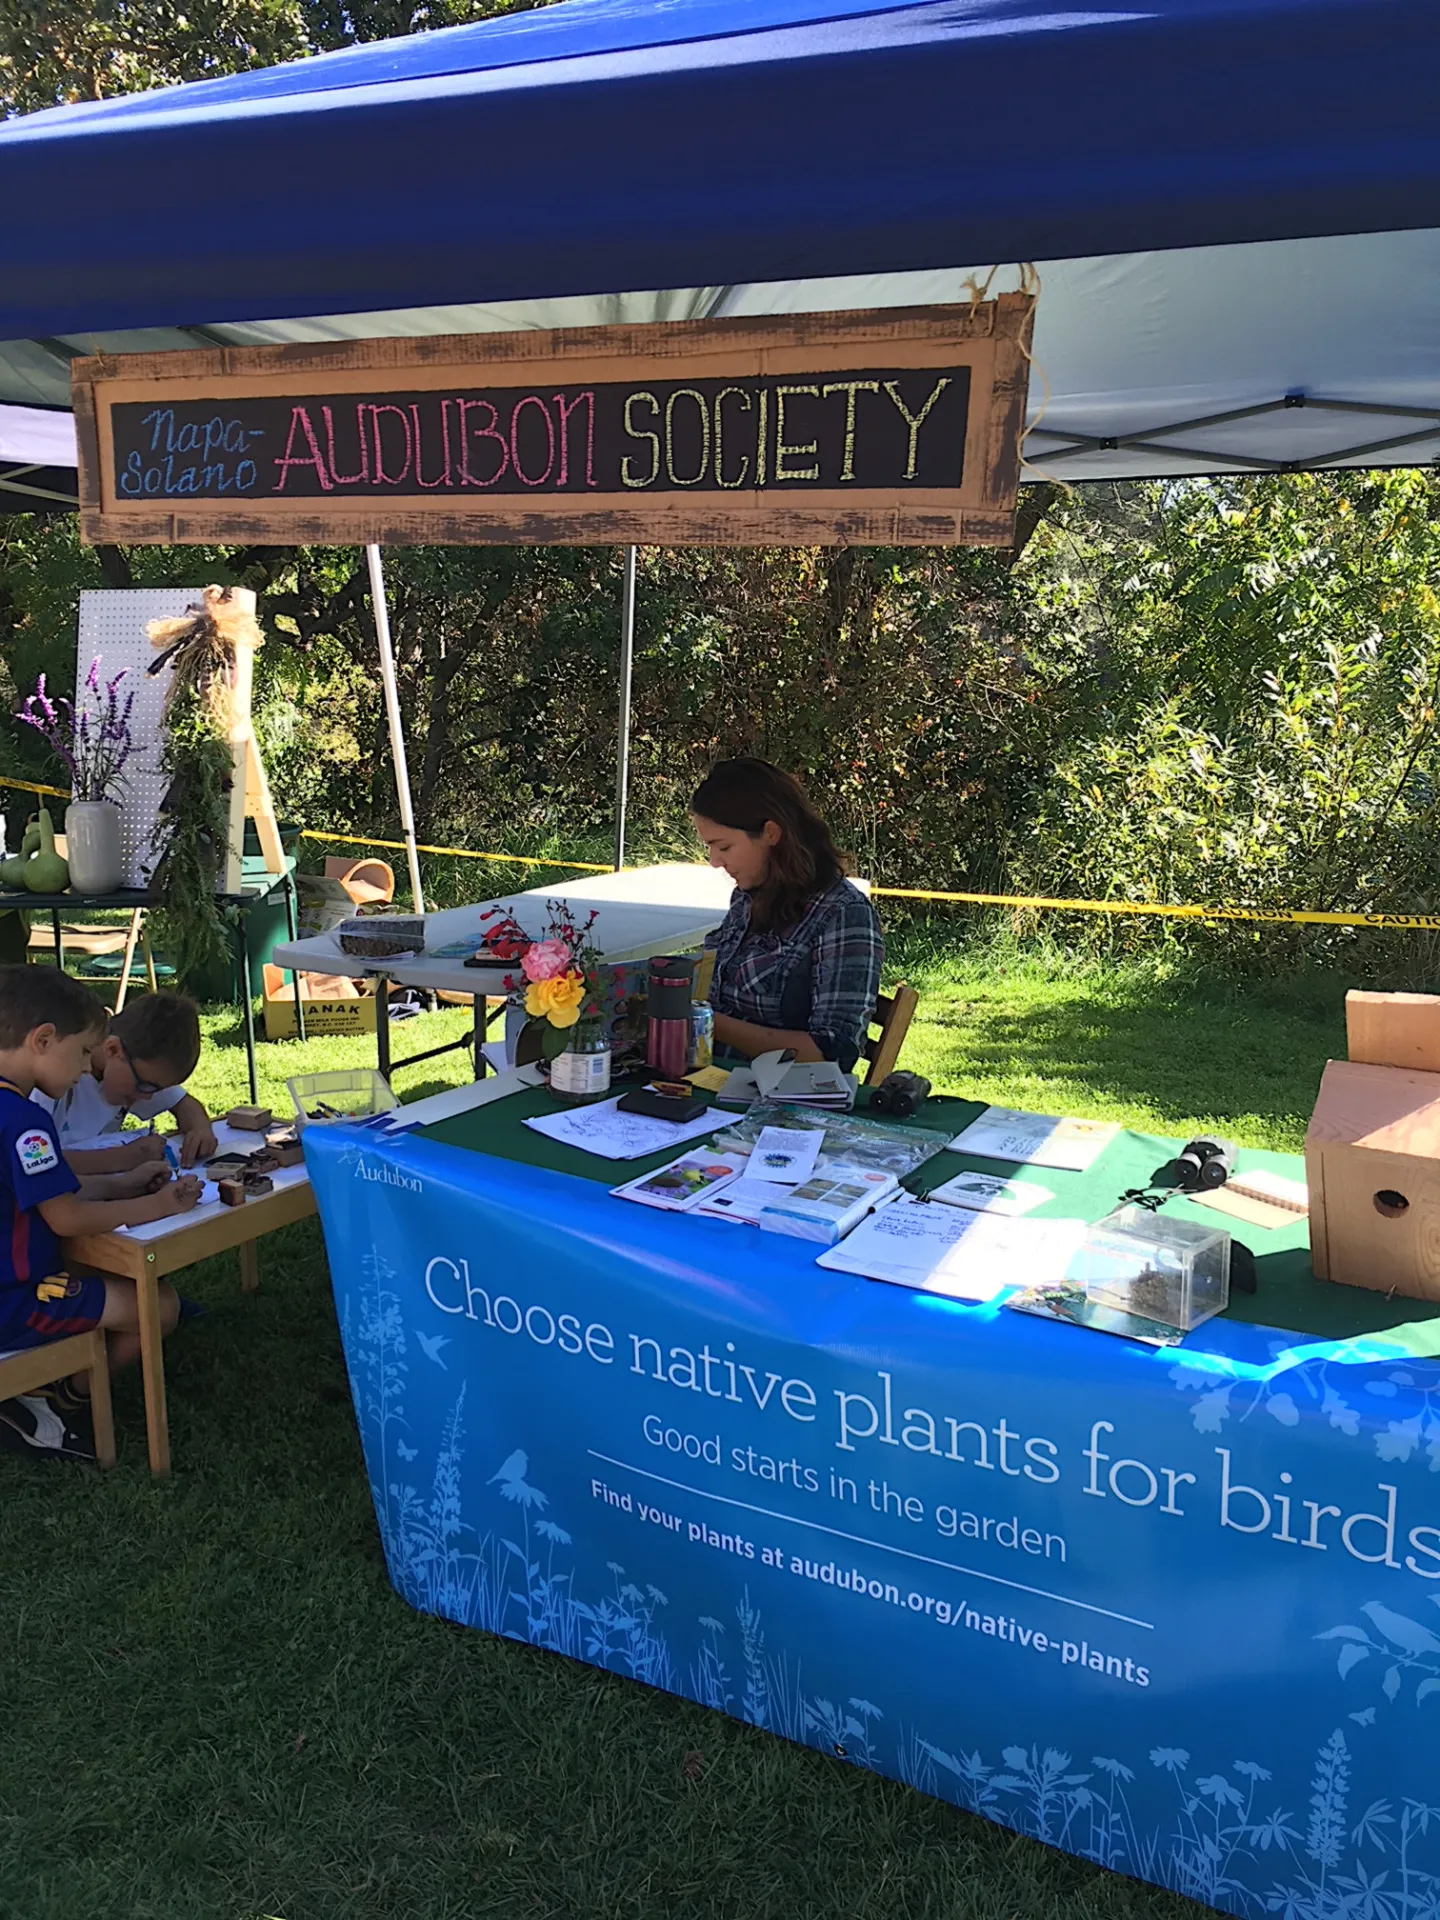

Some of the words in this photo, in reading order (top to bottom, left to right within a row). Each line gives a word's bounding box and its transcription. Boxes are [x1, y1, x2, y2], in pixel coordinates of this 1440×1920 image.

[620, 378, 952, 488] SOCIETY
[119, 452, 257, 494] Solano
[1202, 903, 1293, 919] CAUTION
[294, 1004, 360, 1015] ANAK
[26, 1155, 54, 1170] LaLiga
[353, 1157, 423, 1193] Audubon
[425, 1256, 614, 1364] Choose
[628, 1333, 817, 1422] native
[833, 1371, 1060, 1484] plants
[1082, 1420, 1197, 1517] for
[1214, 1446, 1440, 1579] birds
[643, 1414, 721, 1466] Good
[732, 1445, 820, 1493] starts
[829, 1465, 858, 1504] in
[867, 1479, 925, 1523] the
[935, 1505, 1067, 1563] garden
[591, 1478, 633, 1513] Find
[637, 1500, 683, 1535] your
[687, 1521, 755, 1560] plants
[761, 1546, 784, 1569] at
[789, 1556, 1151, 1688] audubon.org/native-plants
